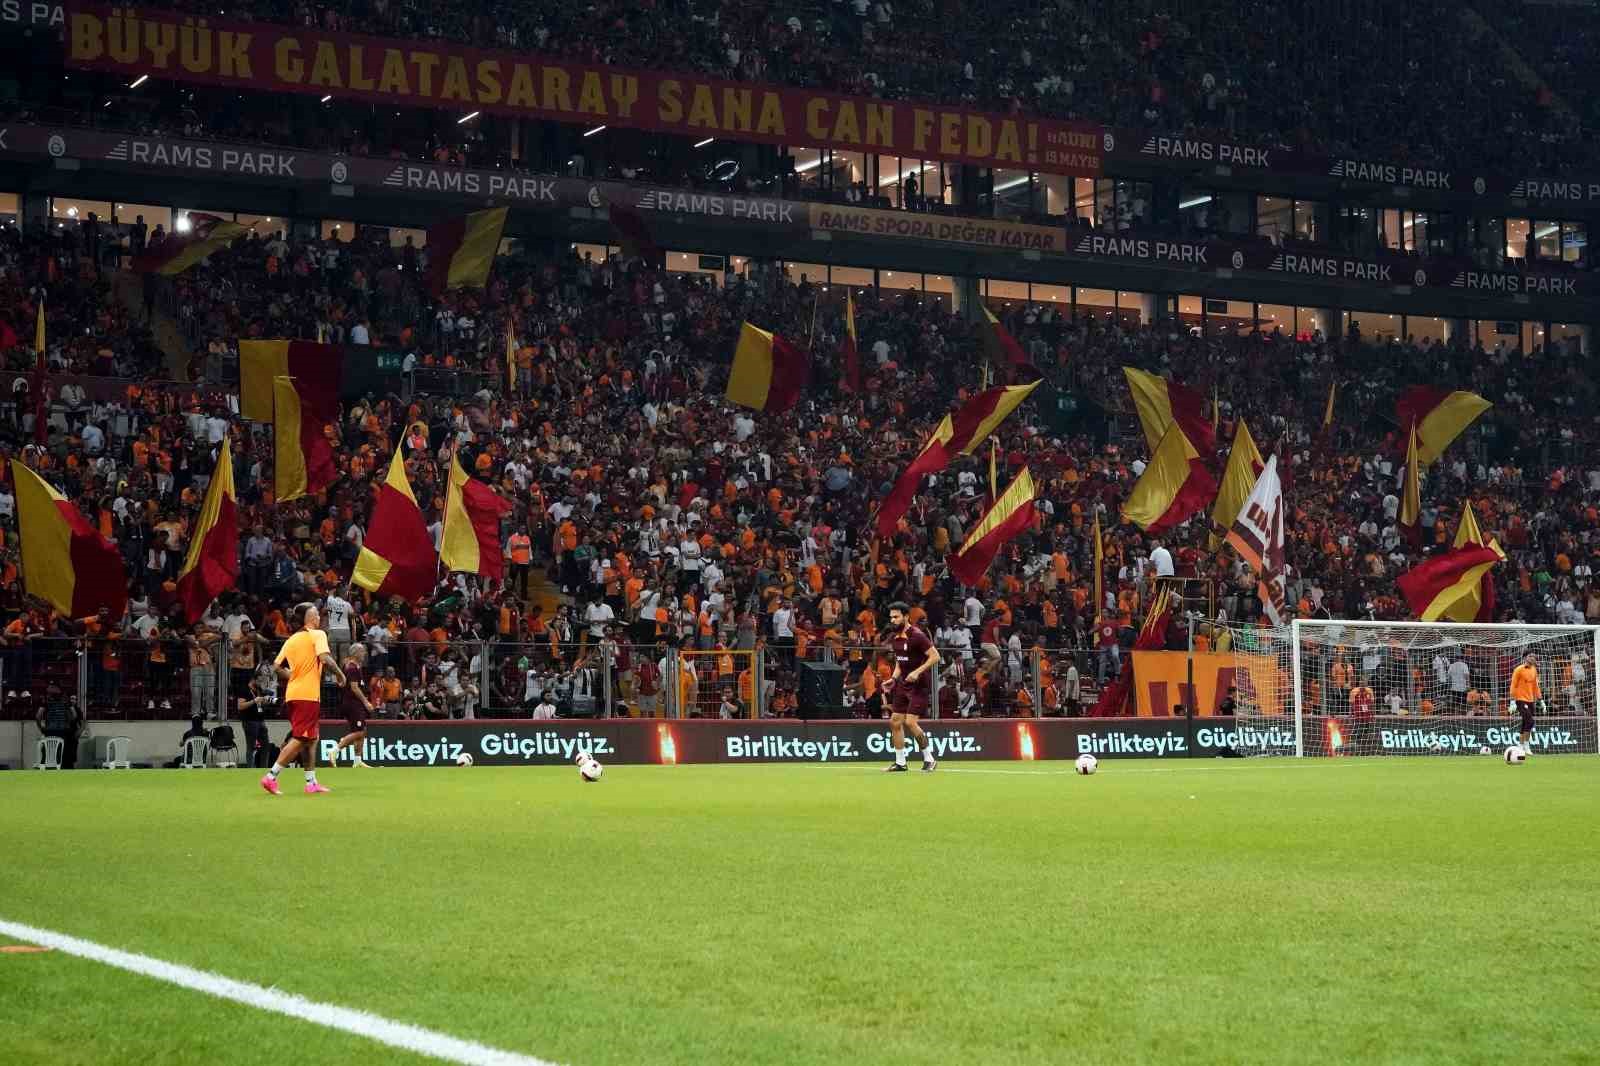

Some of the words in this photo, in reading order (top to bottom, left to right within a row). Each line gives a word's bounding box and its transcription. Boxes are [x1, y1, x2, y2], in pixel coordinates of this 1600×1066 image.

[71, 9, 253, 78] BÜYÜK
[274, 38, 638, 117] GALATASARAY
[657, 80, 787, 137] SANA
[805, 97, 895, 147] CAN
[912, 109, 1040, 165] FEDA!
[132, 142, 213, 169] RAMS
[222, 150, 296, 177] PARK
[1158, 138, 1213, 161] RAMS
[1219, 145, 1270, 168] PARK
[406, 167, 481, 193] RAMS
[488, 175, 557, 201] PARK
[1345, 160, 1397, 183] RAMS
[1402, 168, 1451, 189] PARK
[1527, 181, 1582, 200] RAMS
[657, 191, 725, 216] RAMS
[733, 199, 793, 224] PARK
[819, 209, 869, 234] RAMS
[874, 215, 936, 242] SPORA
[940, 222, 995, 248] DEĞER
[999, 229, 1055, 251] KATAR
[1093, 236, 1150, 259] RAMS
[1156, 242, 1208, 264] PARK
[1284, 254, 1338, 276] RAMS
[1343, 260, 1392, 282] PARK
[1466, 271, 1519, 293] RAMS
[1525, 276, 1577, 296] PARK
[480, 732, 615, 758] Güçlüyüz.
[726, 735, 859, 762] Birlikteyiz.
[1077, 732, 1189, 756] Birlikteyiz.
[1196, 728, 1297, 750] Güçlüyüz.
[1381, 729, 1481, 751] Birlikteyiz.
